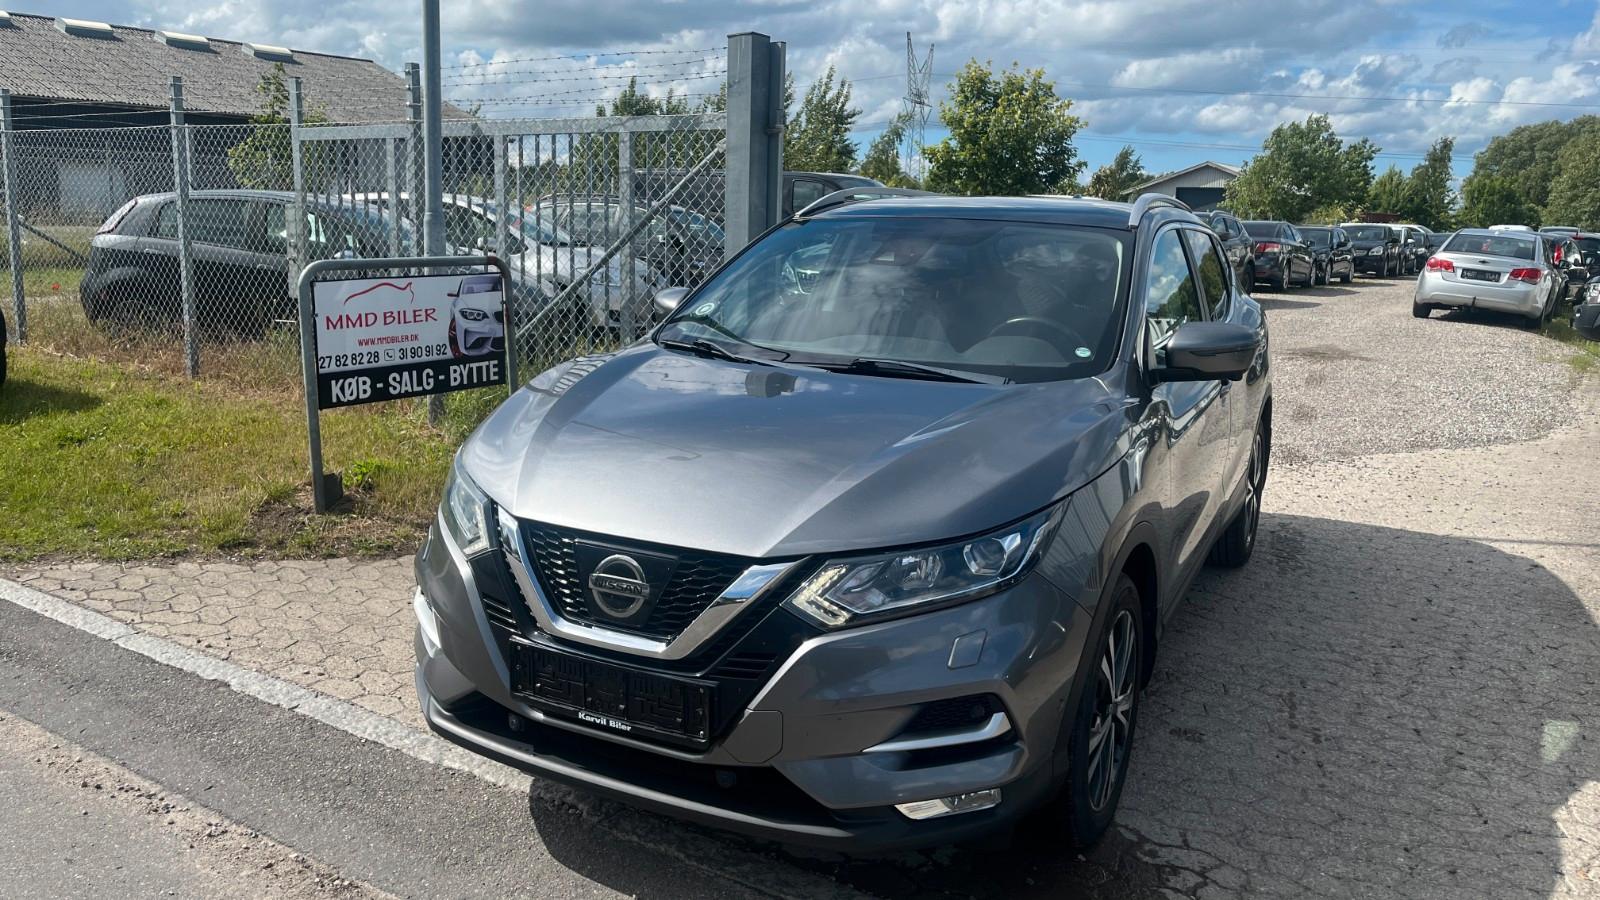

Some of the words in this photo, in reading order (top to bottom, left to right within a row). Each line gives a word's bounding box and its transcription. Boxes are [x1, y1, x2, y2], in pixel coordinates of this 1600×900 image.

[325, 312, 378, 330] MMD
[383, 308, 438, 326] BILER
[331, 376, 372, 403] KØB
[388, 368, 434, 395] SALG
[449, 360, 499, 387] BYTTE
[595, 578, 643, 593] NISSAN
[578, 711, 607, 726] Karvil
[609, 719, 632, 732] Biler
